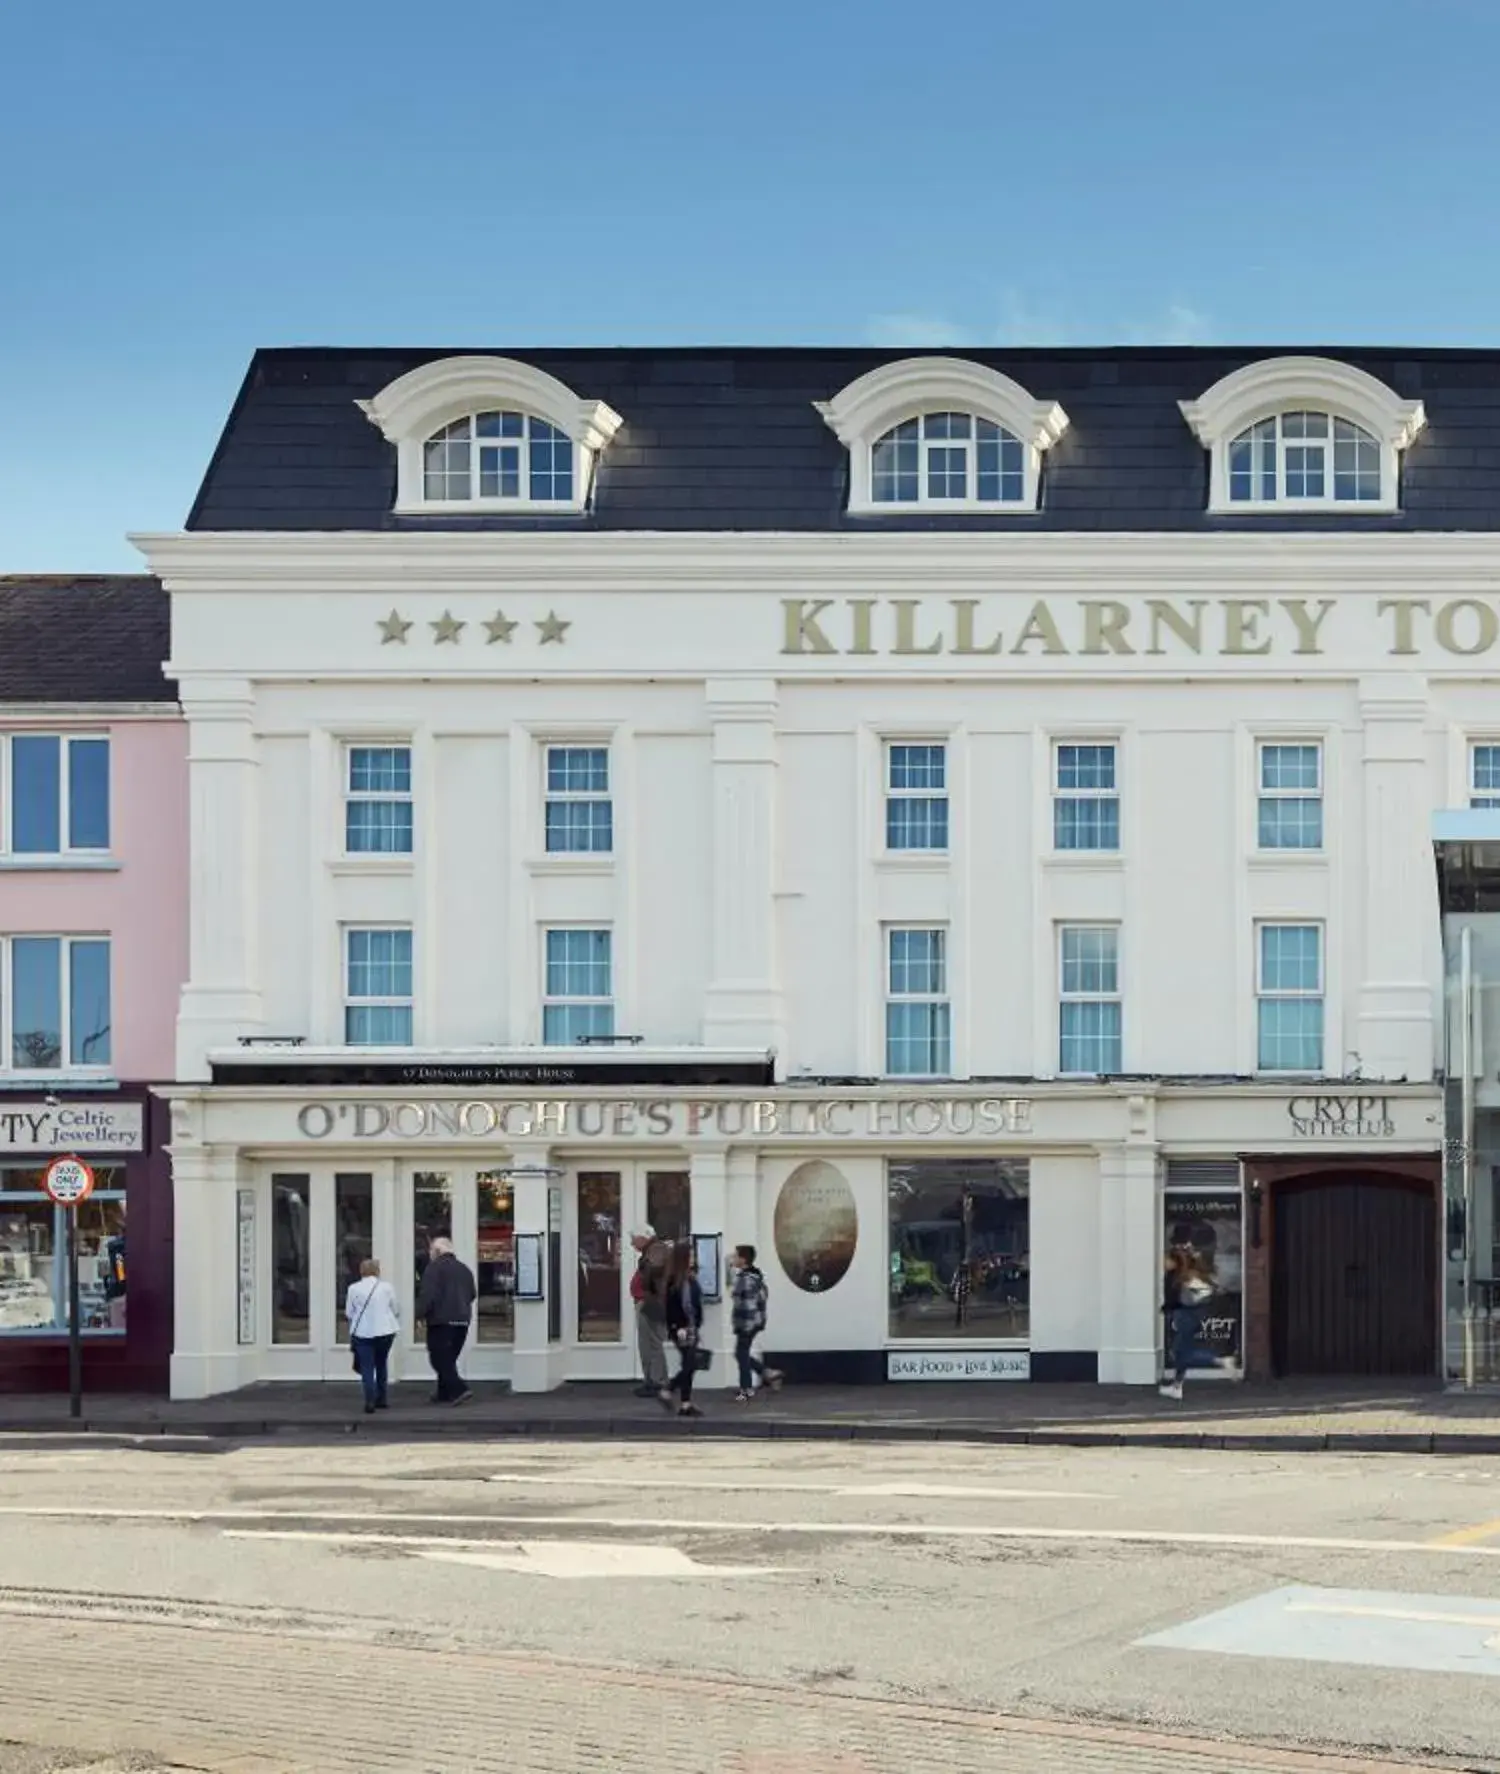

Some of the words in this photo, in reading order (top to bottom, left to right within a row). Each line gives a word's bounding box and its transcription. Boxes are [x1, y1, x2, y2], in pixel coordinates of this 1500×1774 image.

[778, 599, 1337, 656] KILLARNEY
[58, 1109, 115, 1126] Celtic
[297, 1100, 674, 1139] O'DONOGHUE'S
[684, 1099, 854, 1136] PUBLIC
[866, 1098, 1034, 1135] HOUSE
[1287, 1096, 1391, 1121] CRYPT
[49, 1126, 138, 1146] Jewellery
[919, 1356, 955, 1375] FOOD
